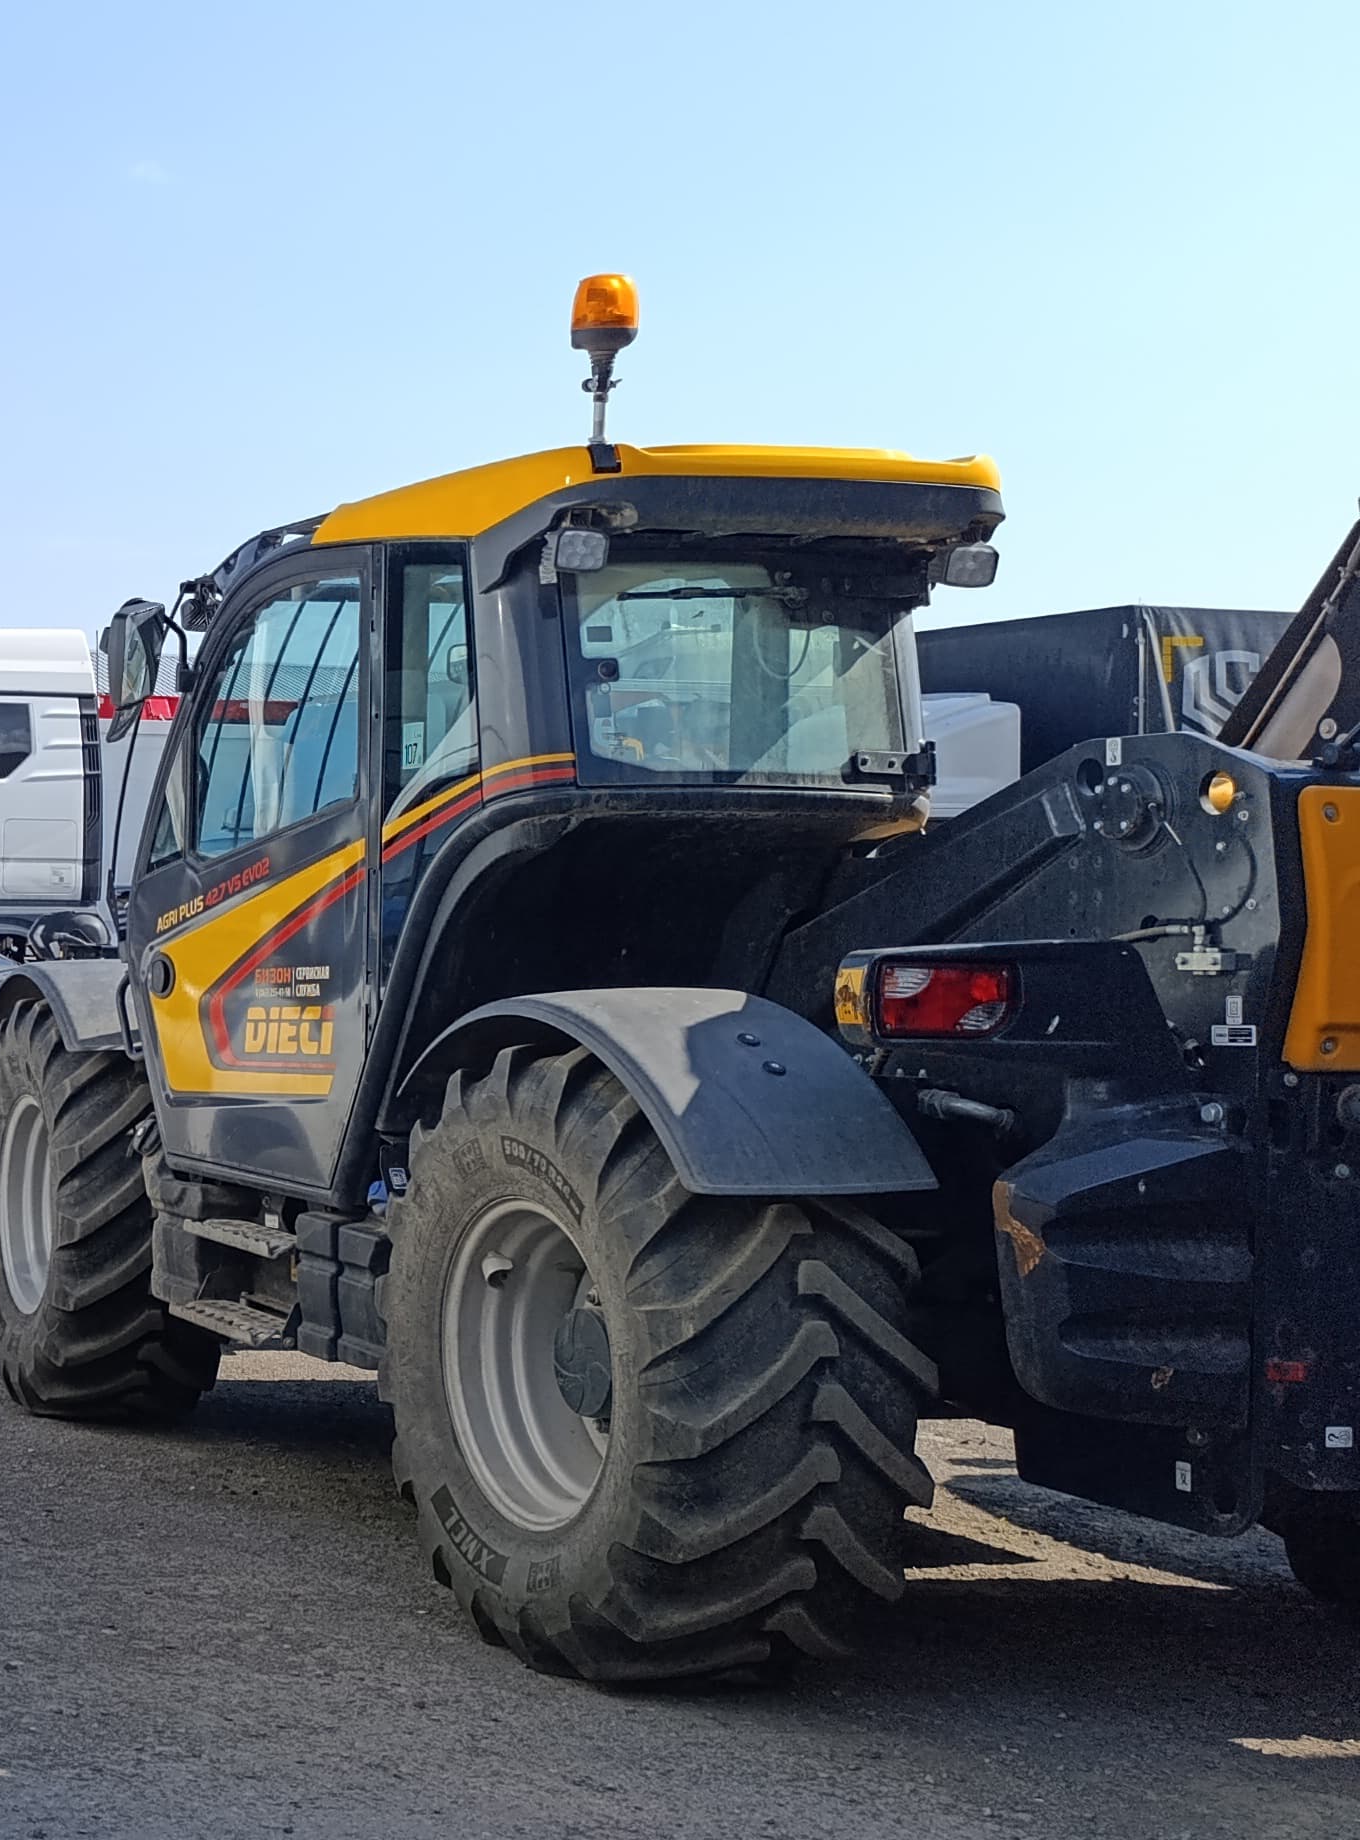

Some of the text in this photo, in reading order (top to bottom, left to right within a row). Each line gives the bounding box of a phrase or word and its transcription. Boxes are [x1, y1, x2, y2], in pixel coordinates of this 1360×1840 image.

[156, 905, 178, 934] AGRI
[179, 895, 204, 922] PLUS
[242, 856, 270, 887] EVO2
[244, 1005, 335, 1055] DIECI
[443, 1506, 496, 1575] XMCL
